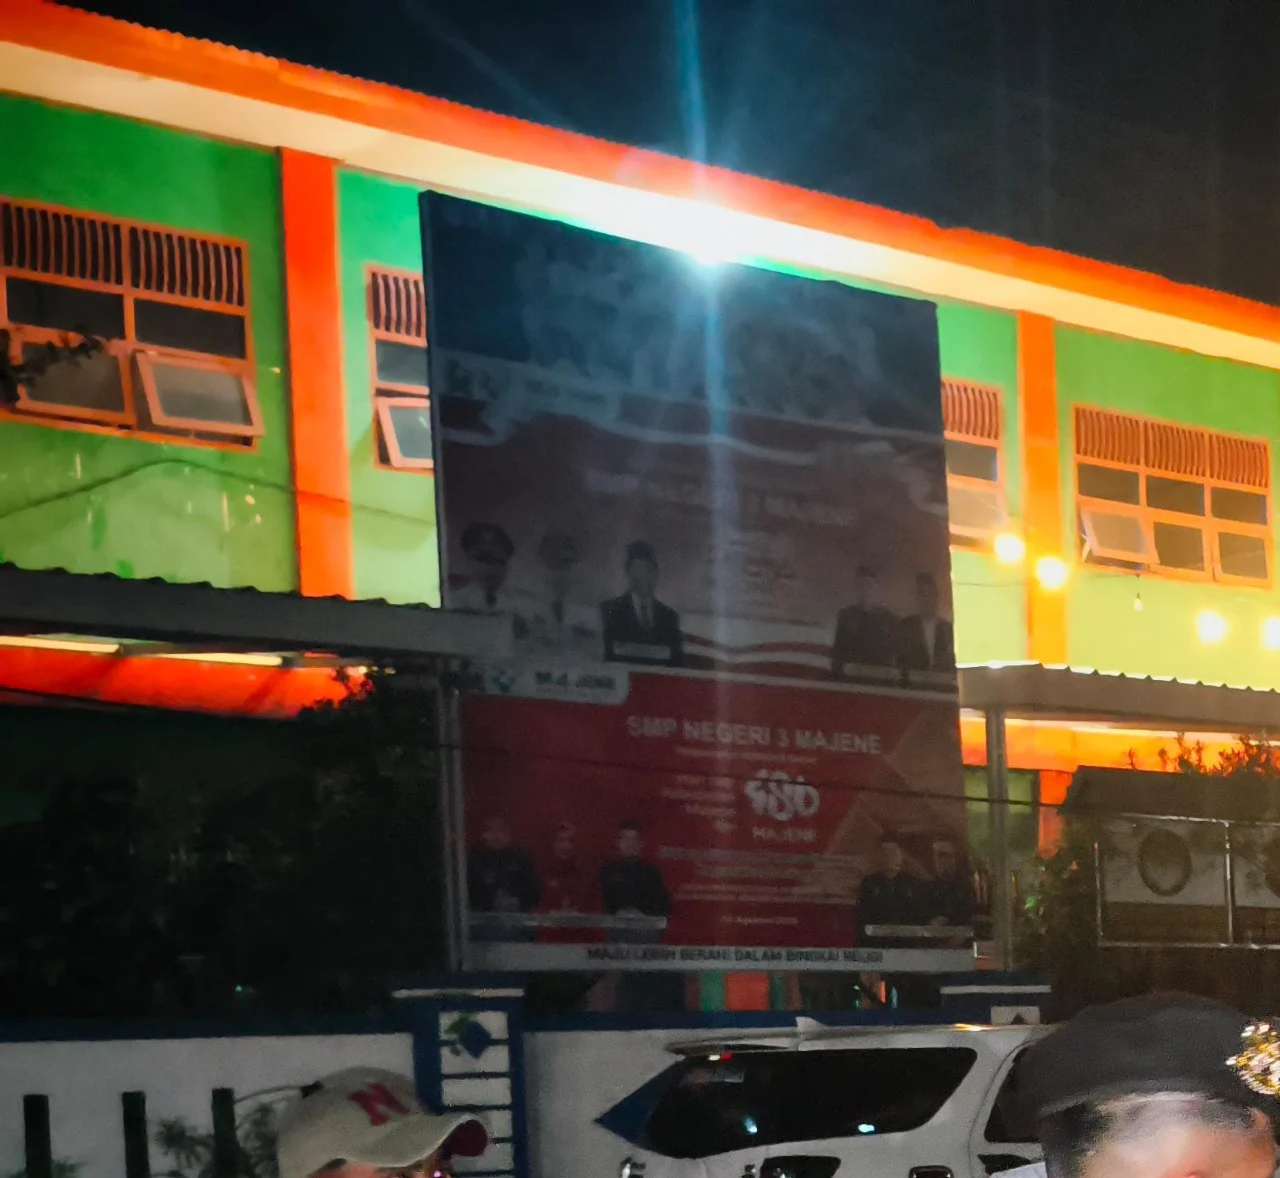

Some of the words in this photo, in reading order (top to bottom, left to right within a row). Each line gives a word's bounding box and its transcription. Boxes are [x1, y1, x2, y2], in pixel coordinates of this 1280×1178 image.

[626, 714, 677, 738] SMP
[682, 718, 771, 748] NEGERI
[795, 728, 881, 754] MAJENE
